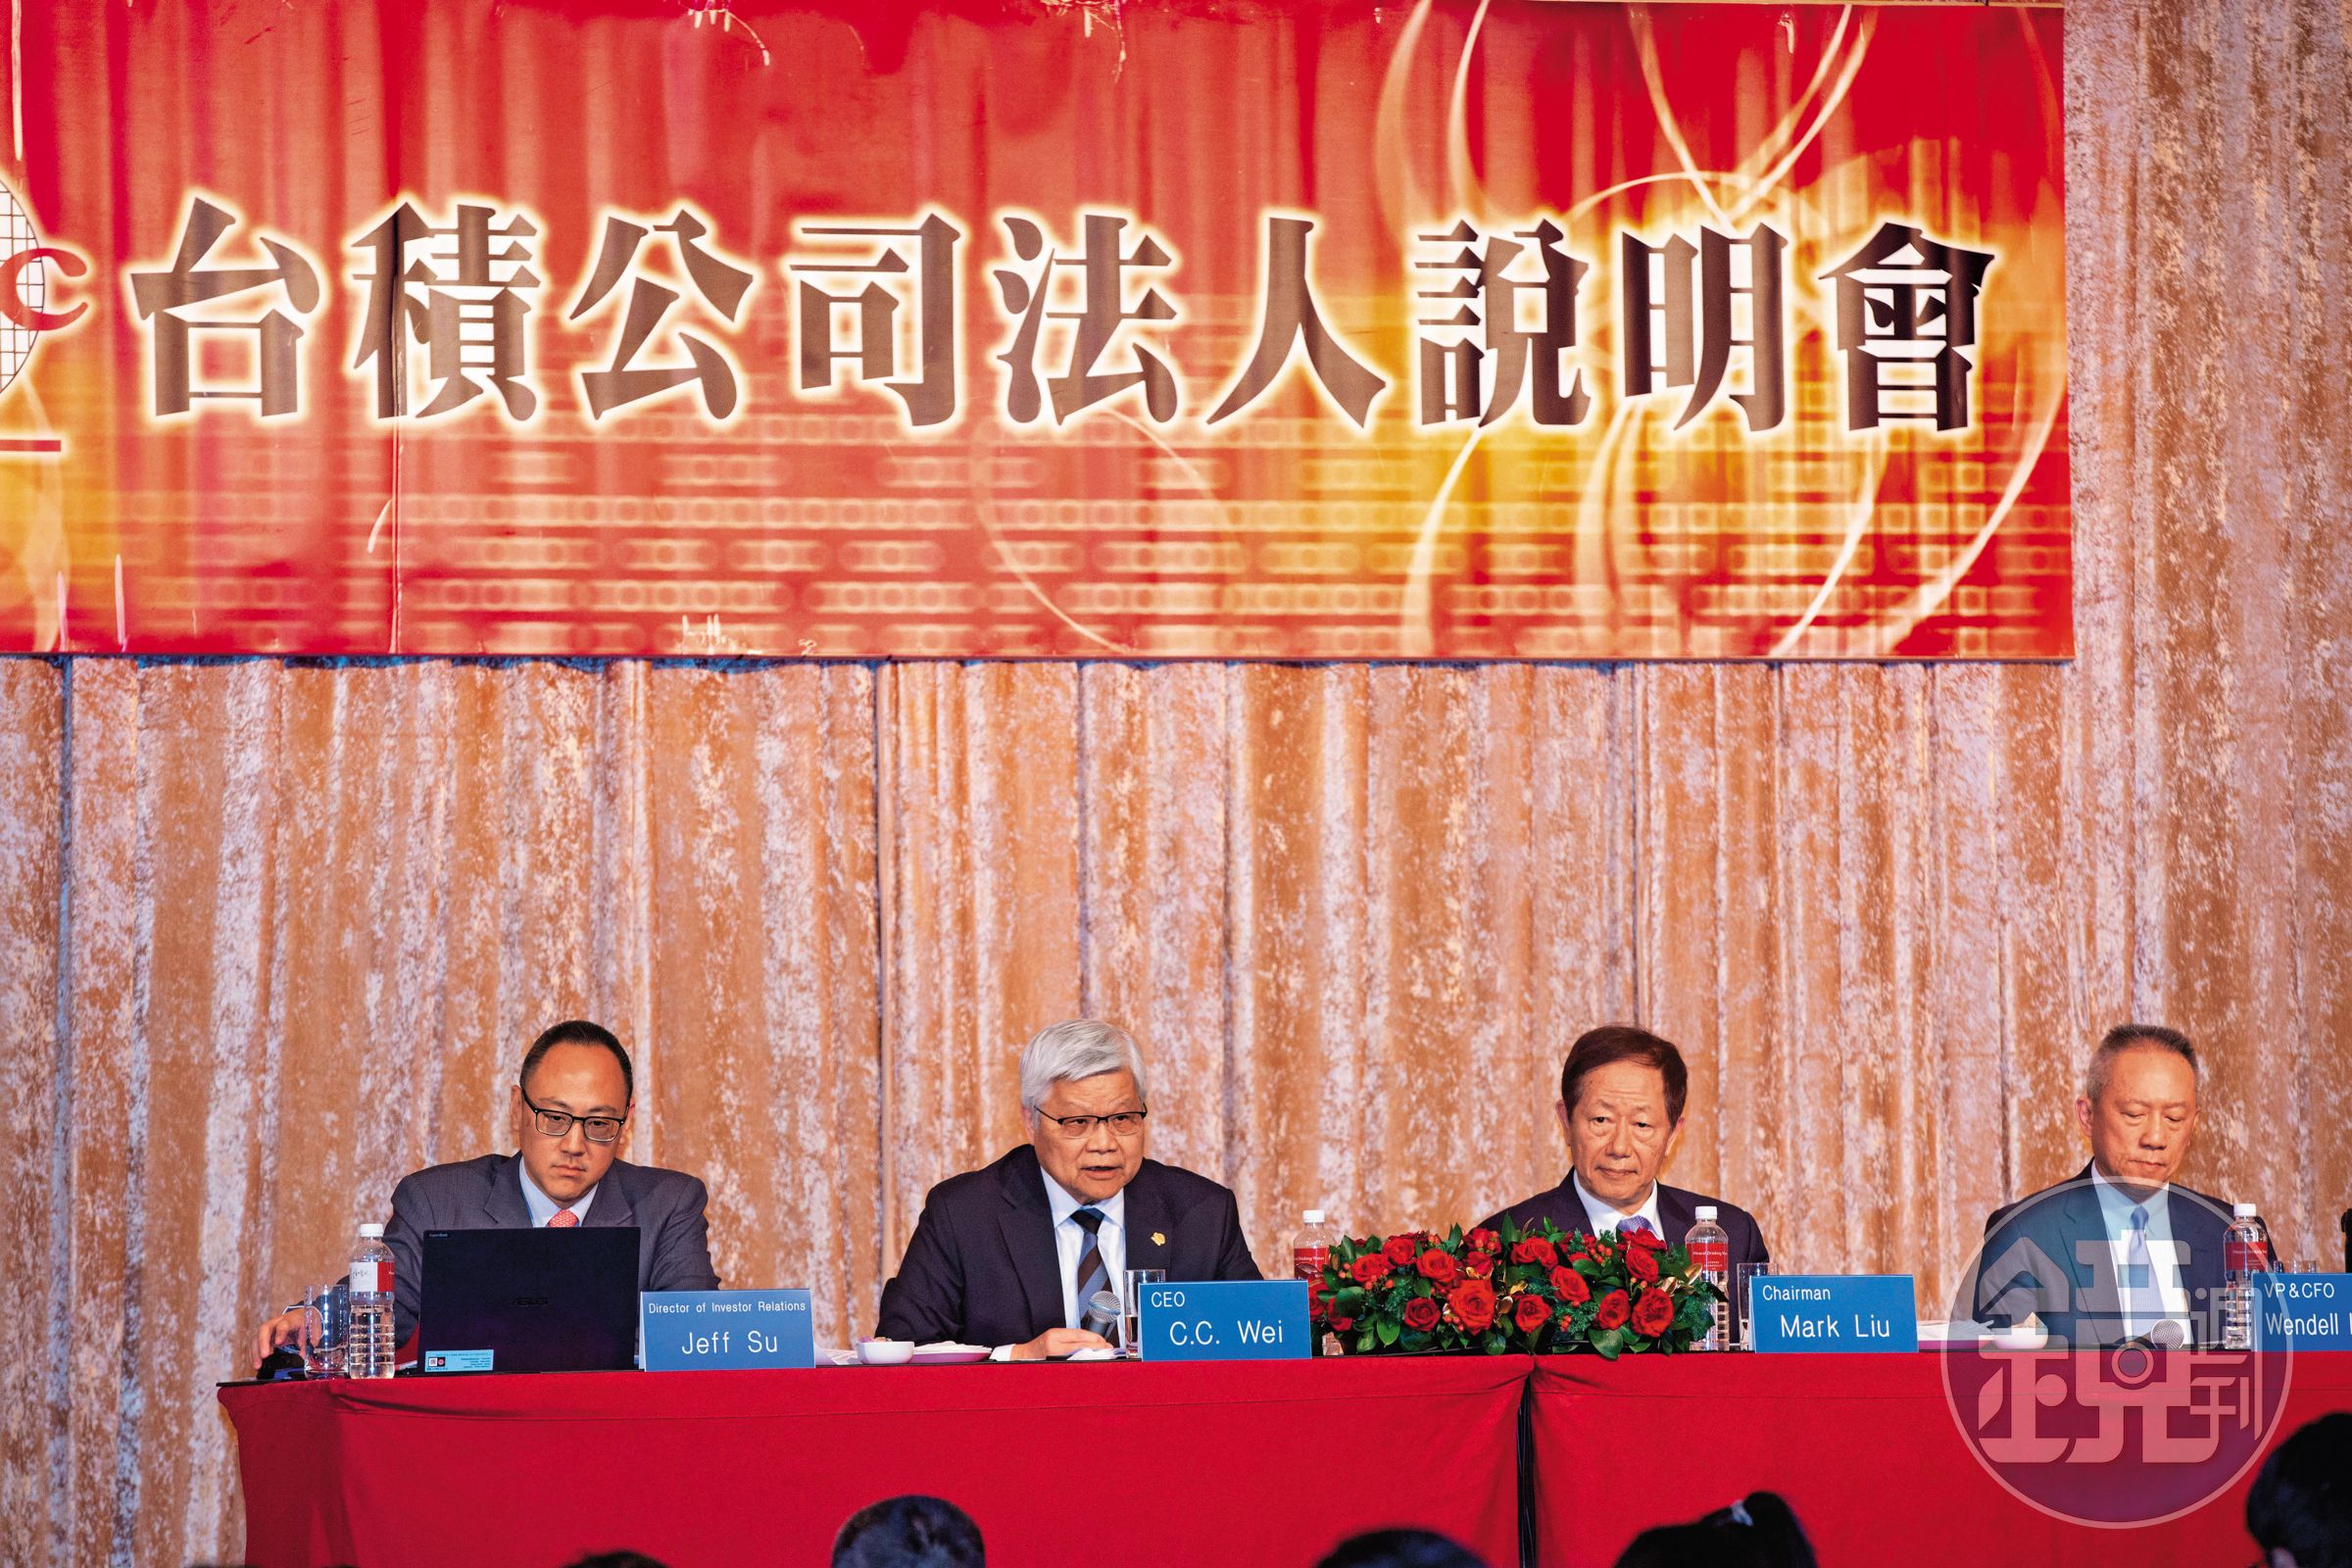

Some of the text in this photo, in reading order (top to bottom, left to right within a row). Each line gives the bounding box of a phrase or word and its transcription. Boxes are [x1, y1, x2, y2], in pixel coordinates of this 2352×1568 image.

[130, 197, 1996, 432] 台積公司法人說明會
[1151, 1291, 1186, 1308] CEO
[1762, 1285, 1832, 1300] Chairman
[648, 1300, 807, 1314] Director of Investor Relations
[1169, 1319, 1283, 1347] C.C. Wei
[1780, 1313, 1891, 1338] Mark Liu
[2265, 1312, 2339, 1336] Wendell
[681, 1330, 778, 1354] Jeff Su
